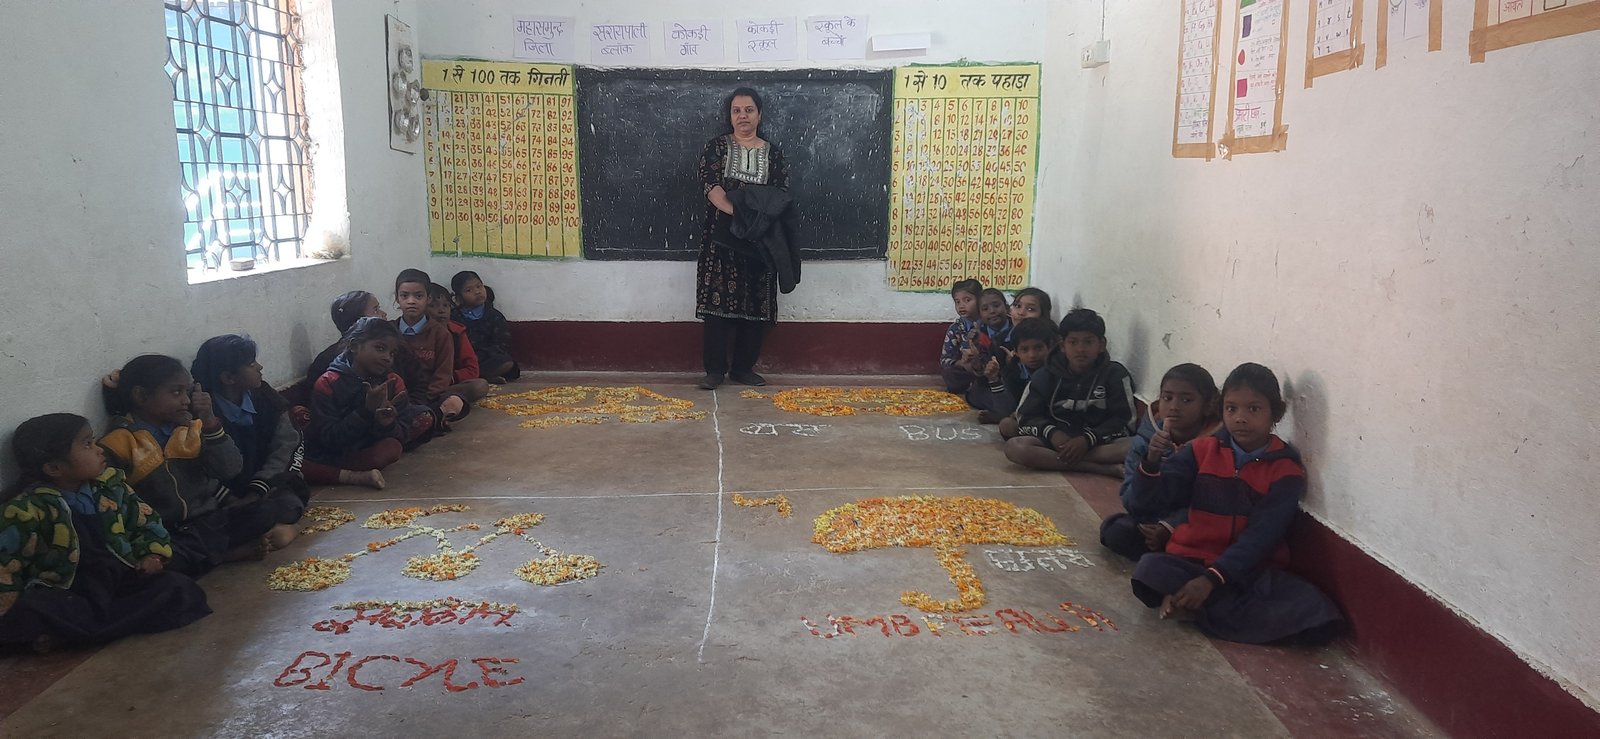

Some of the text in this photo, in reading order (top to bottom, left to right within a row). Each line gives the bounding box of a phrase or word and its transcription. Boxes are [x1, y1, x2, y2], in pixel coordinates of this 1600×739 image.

[524, 38, 555, 57] जिला
[442, 65, 570, 87] 1 से 100 तक गिनती
[904, 71, 1031, 95] 1 से 10 तक पहाड़ा
[485, 95, 495, 103] 41
[546, 97, 556, 106] 81
[561, 97, 571, 106] 91
[934, 101, 940, 110] 4
[948, 100, 955, 109] 5
[961, 100, 968, 110] 6
[976, 101, 982, 110] 7
[991, 100, 997, 110] 8
[1019, 100, 1028, 110] 10
[531, 110, 541, 118] 72
[547, 111, 557, 120] 82
[562, 112, 572, 120] 92
[934, 114, 1028, 126] 8 10 12 14 20
[547, 123, 557, 132] 83
[562, 124, 572, 133] 93
[933, 130, 942, 139] 12
[515, 135, 526, 144] 64
[532, 136, 541, 144] 74
[548, 136, 557, 145] 84
[562, 138, 573, 147] 94
[471, 145, 574, 160] 35 65 75 85 95
[894, 145, 1010, 156] 4 16 36
[472, 159, 482, 167] 36
[501, 160, 512, 168] 56
[516, 160, 527, 169] 66
[548, 163, 557, 172] 86
[563, 163, 573, 173] 96
[893, 161, 899, 171] 5
[502, 174, 512, 182] 57
[516, 174, 527, 183] 67
[548, 176, 559, 186] 87
[563, 176, 575, 187] 97
[892, 176, 1025, 189] 6 42 60
[488, 188, 498, 196] 48
[503, 187, 513, 196] 58
[533, 189, 543, 199] 78
[564, 190, 576, 200] 98
[956, 192, 1023, 204] 42 56 70
[517, 202, 576, 214] 69 79 89 99
[892, 209, 898, 220] 8
[969, 209, 980, 218] 56
[983, 208, 995, 219] 64
[1012, 208, 1023, 219] 80
[458, 213, 469, 221] 30
[504, 215, 514, 224] 60
[518, 215, 528, 224] 70
[533, 216, 544, 226] 80
[548, 217, 559, 226] 90
[892, 224, 897, 235] 9
[929, 225, 938, 235] 36
[941, 225, 952, 236] 45
[983, 224, 992, 236] 72
[1010, 224, 1021, 235] 90
[928, 240, 938, 251] 40
[941, 241, 951, 251] 50
[982, 241, 993, 253] 80
[994, 241, 1006, 253] 90
[902, 260, 911, 270] 22
[927, 260, 937, 269] 44
[981, 259, 992, 270] 88
[994, 259, 1007, 270] 99
[1010, 259, 1024, 269] 110
[924, 275, 1022, 286] 48 60 96 120
[898, 424, 982, 442] BUS
